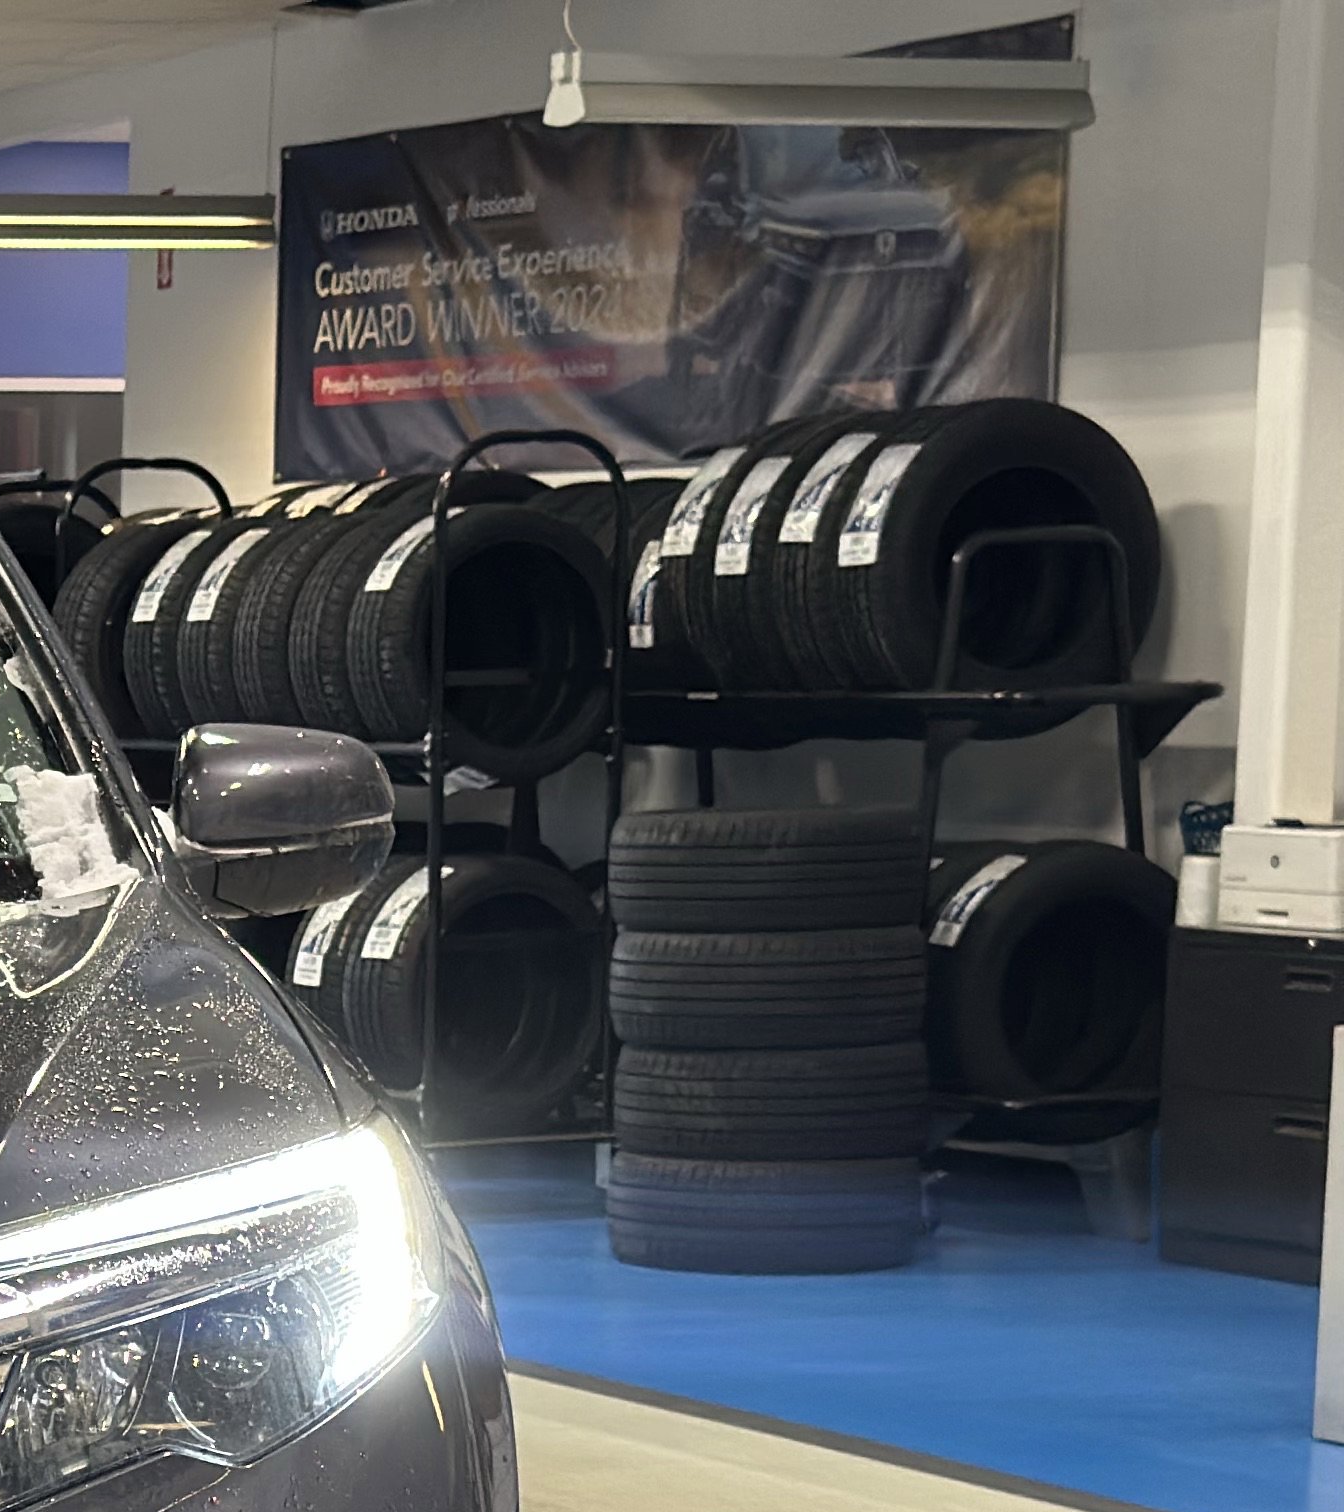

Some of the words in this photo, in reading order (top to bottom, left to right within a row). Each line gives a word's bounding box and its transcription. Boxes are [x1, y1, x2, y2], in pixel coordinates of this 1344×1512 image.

[335, 204, 419, 235] HONDA
[315, 261, 414, 297] Customer
[422, 248, 493, 286] Service
[313, 303, 416, 353] AWARD
[426, 291, 543, 343] WINNER
